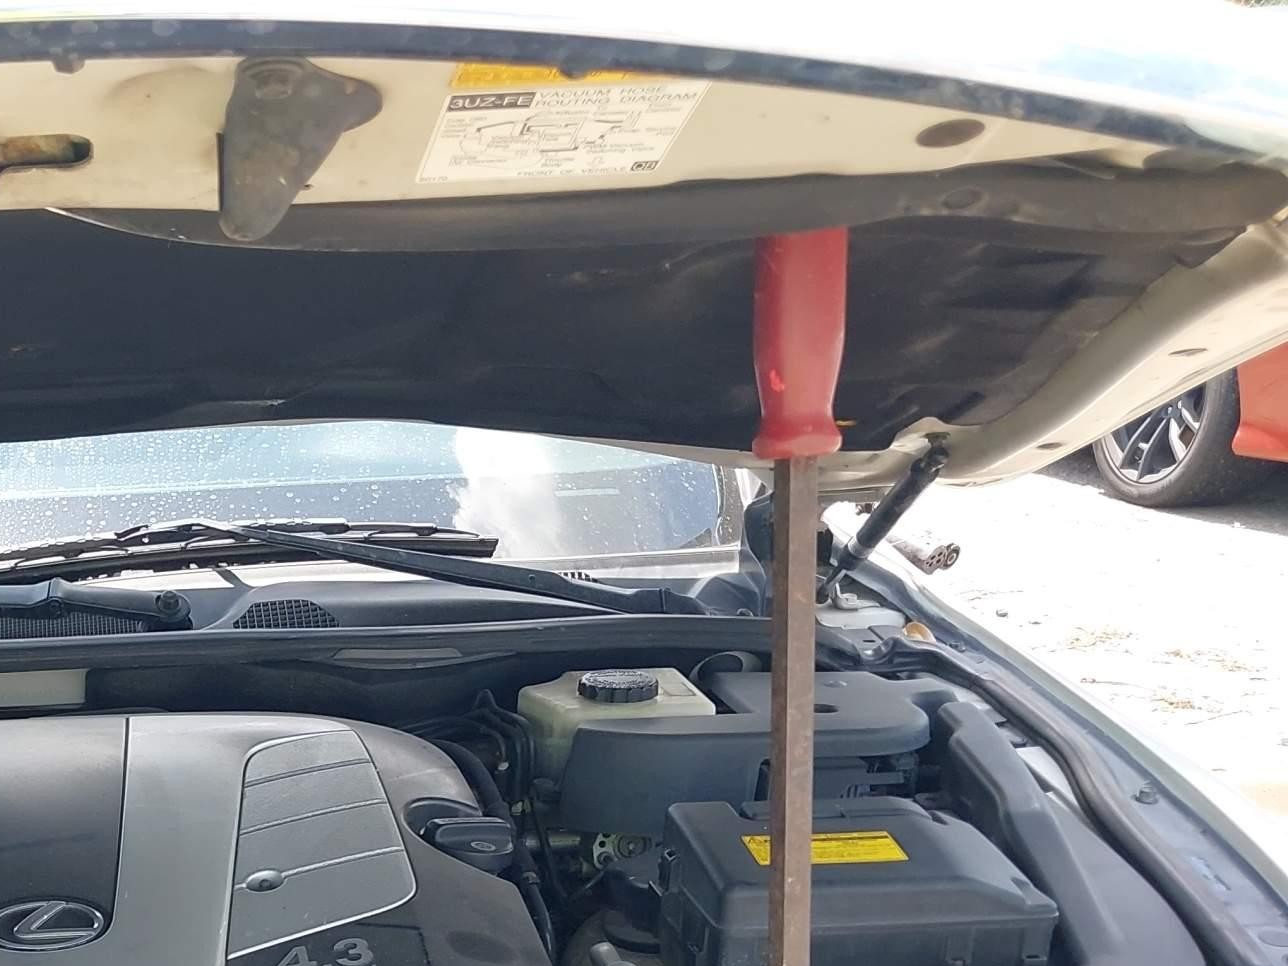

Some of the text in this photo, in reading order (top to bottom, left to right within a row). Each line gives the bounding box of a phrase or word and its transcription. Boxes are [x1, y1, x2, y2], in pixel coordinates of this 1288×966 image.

[538, 88, 611, 98] VACUUM
[619, 92, 698, 103] DIAGRAM
[449, 95, 533, 109] 3UZ-FE
